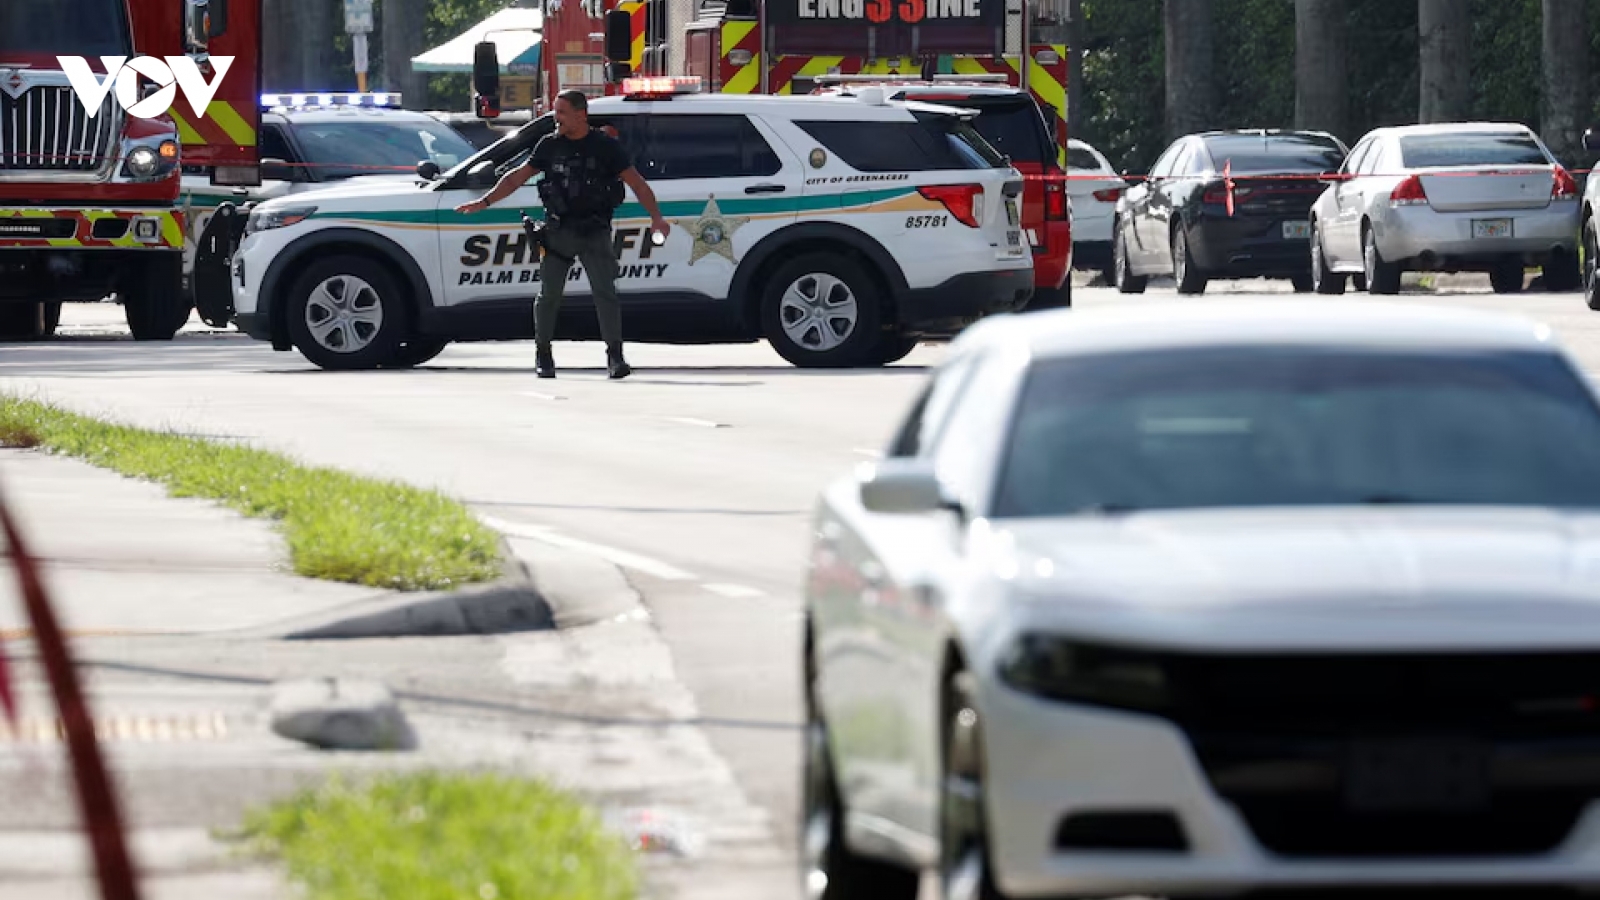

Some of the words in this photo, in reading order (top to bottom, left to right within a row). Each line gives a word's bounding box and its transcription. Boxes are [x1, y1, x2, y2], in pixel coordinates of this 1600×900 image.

[806, 177, 827, 186] CITY
[830, 176, 843, 184] OF
[905, 215, 948, 229] 85781
[460, 228, 666, 266] SHFF
[458, 271, 513, 286] PALM
[518, 267, 582, 283] BEH
[618, 264, 669, 279] UNTY
